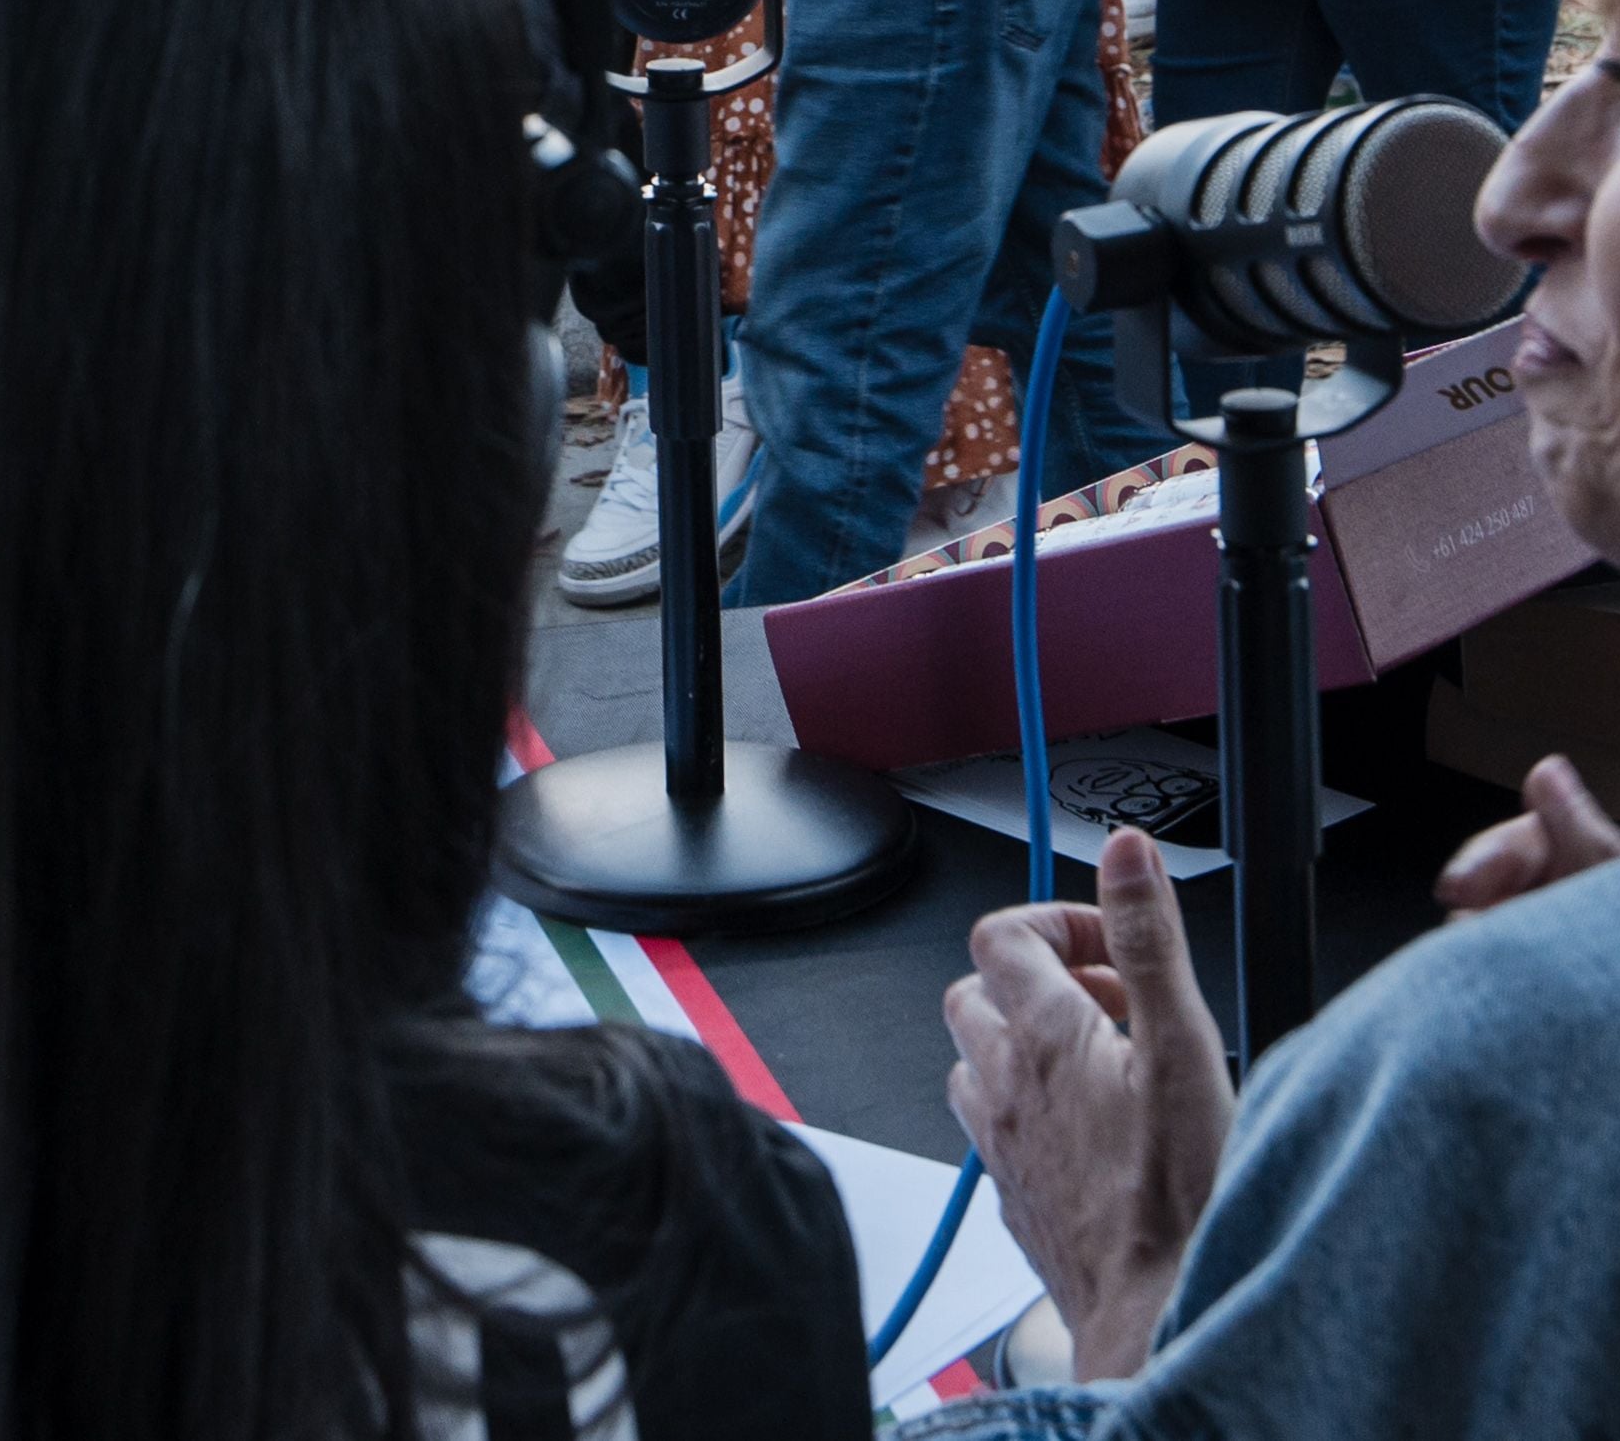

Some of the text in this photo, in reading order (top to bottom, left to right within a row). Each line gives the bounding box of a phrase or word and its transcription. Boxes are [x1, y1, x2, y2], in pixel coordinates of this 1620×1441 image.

[1433, 494, 1536, 560] +61 424 250 487
